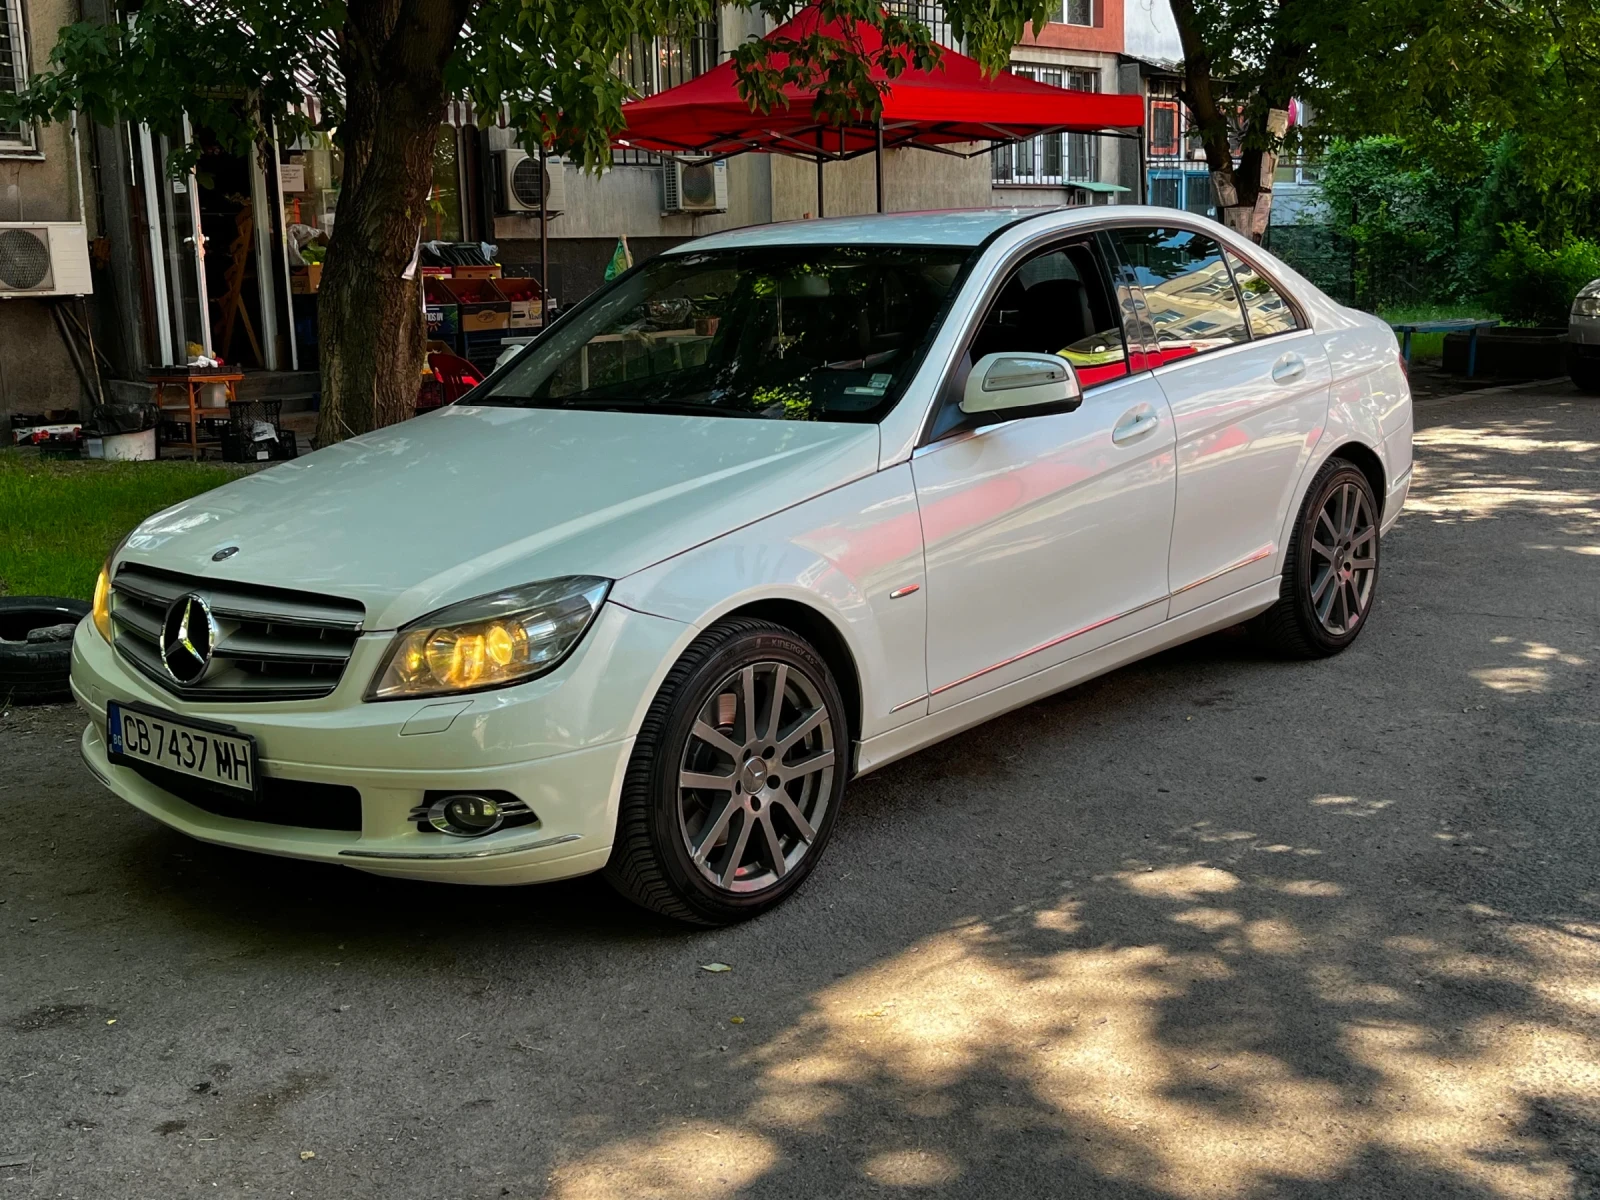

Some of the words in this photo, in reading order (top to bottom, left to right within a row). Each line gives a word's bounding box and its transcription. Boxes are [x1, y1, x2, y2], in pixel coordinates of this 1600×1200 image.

[771, 638, 806, 656] KINERGY
[113, 733, 122, 746] BG
[123, 715, 151, 755] CB
[153, 723, 207, 772] 7437
[213, 739, 250, 784] MH
